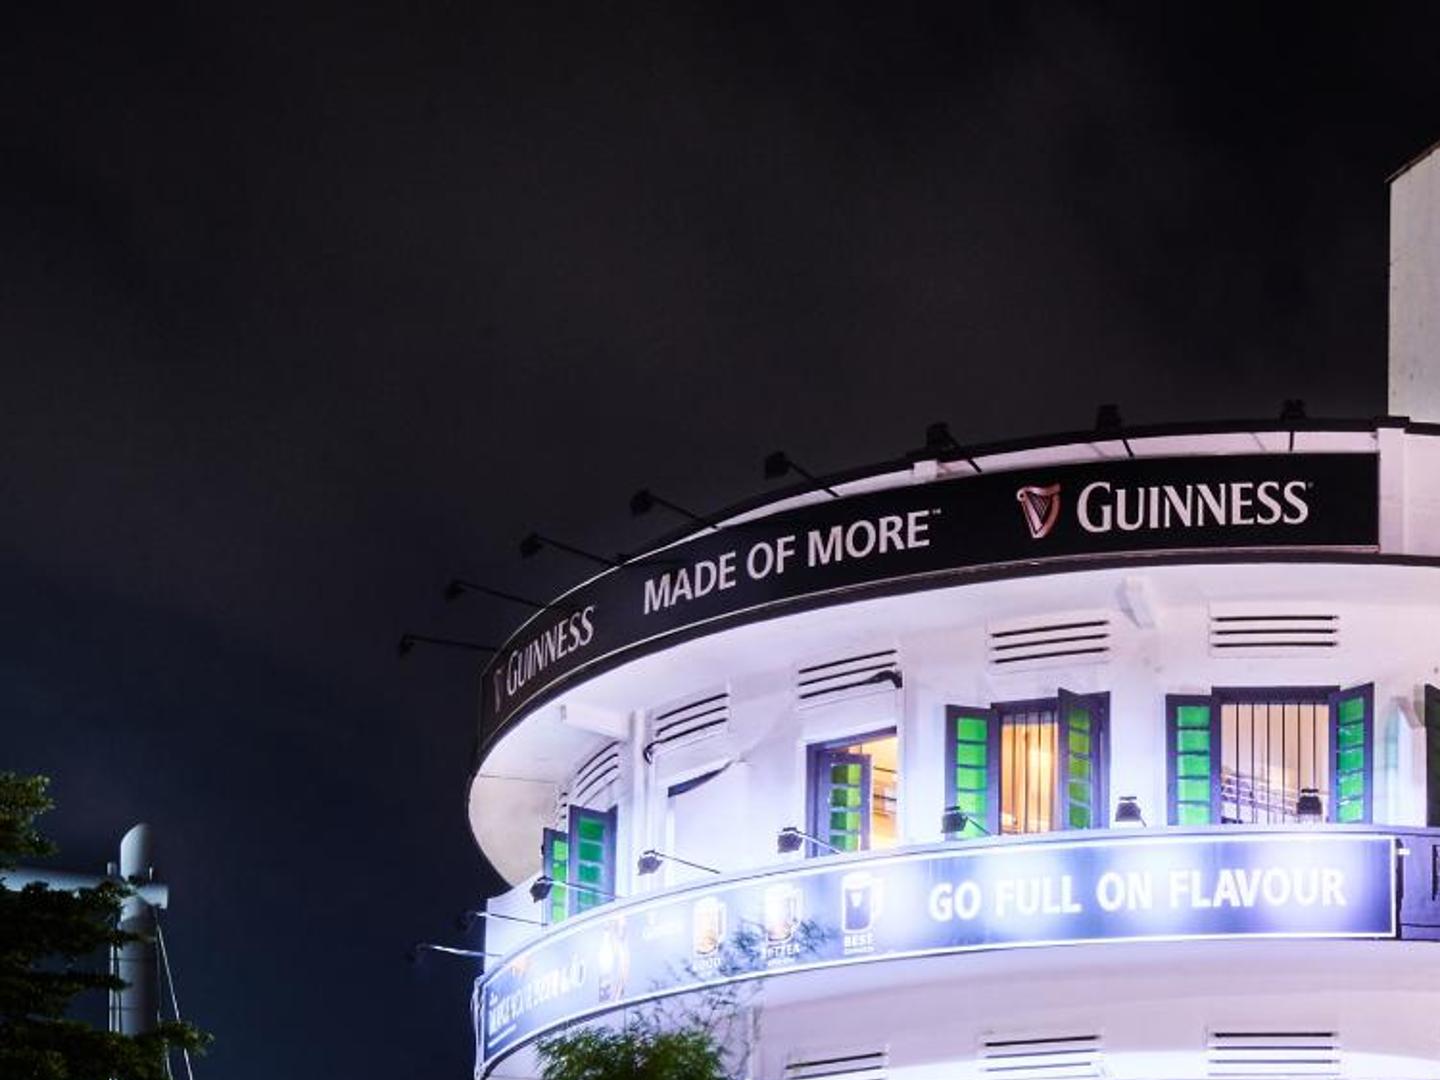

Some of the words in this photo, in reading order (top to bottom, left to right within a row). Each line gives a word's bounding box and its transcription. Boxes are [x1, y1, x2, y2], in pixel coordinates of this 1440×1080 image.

[1076, 481, 1310, 534] GUINNESS
[642, 551, 737, 615] MADE
[745, 535, 797, 581] OF
[806, 509, 930, 567] MORE
[505, 604, 595, 696] GUINNESS
[928, 881, 981, 922] GO
[993, 875, 1083, 916] FULL
[1096, 872, 1152, 912] ON
[1169, 867, 1347, 909] FLAVOUR
